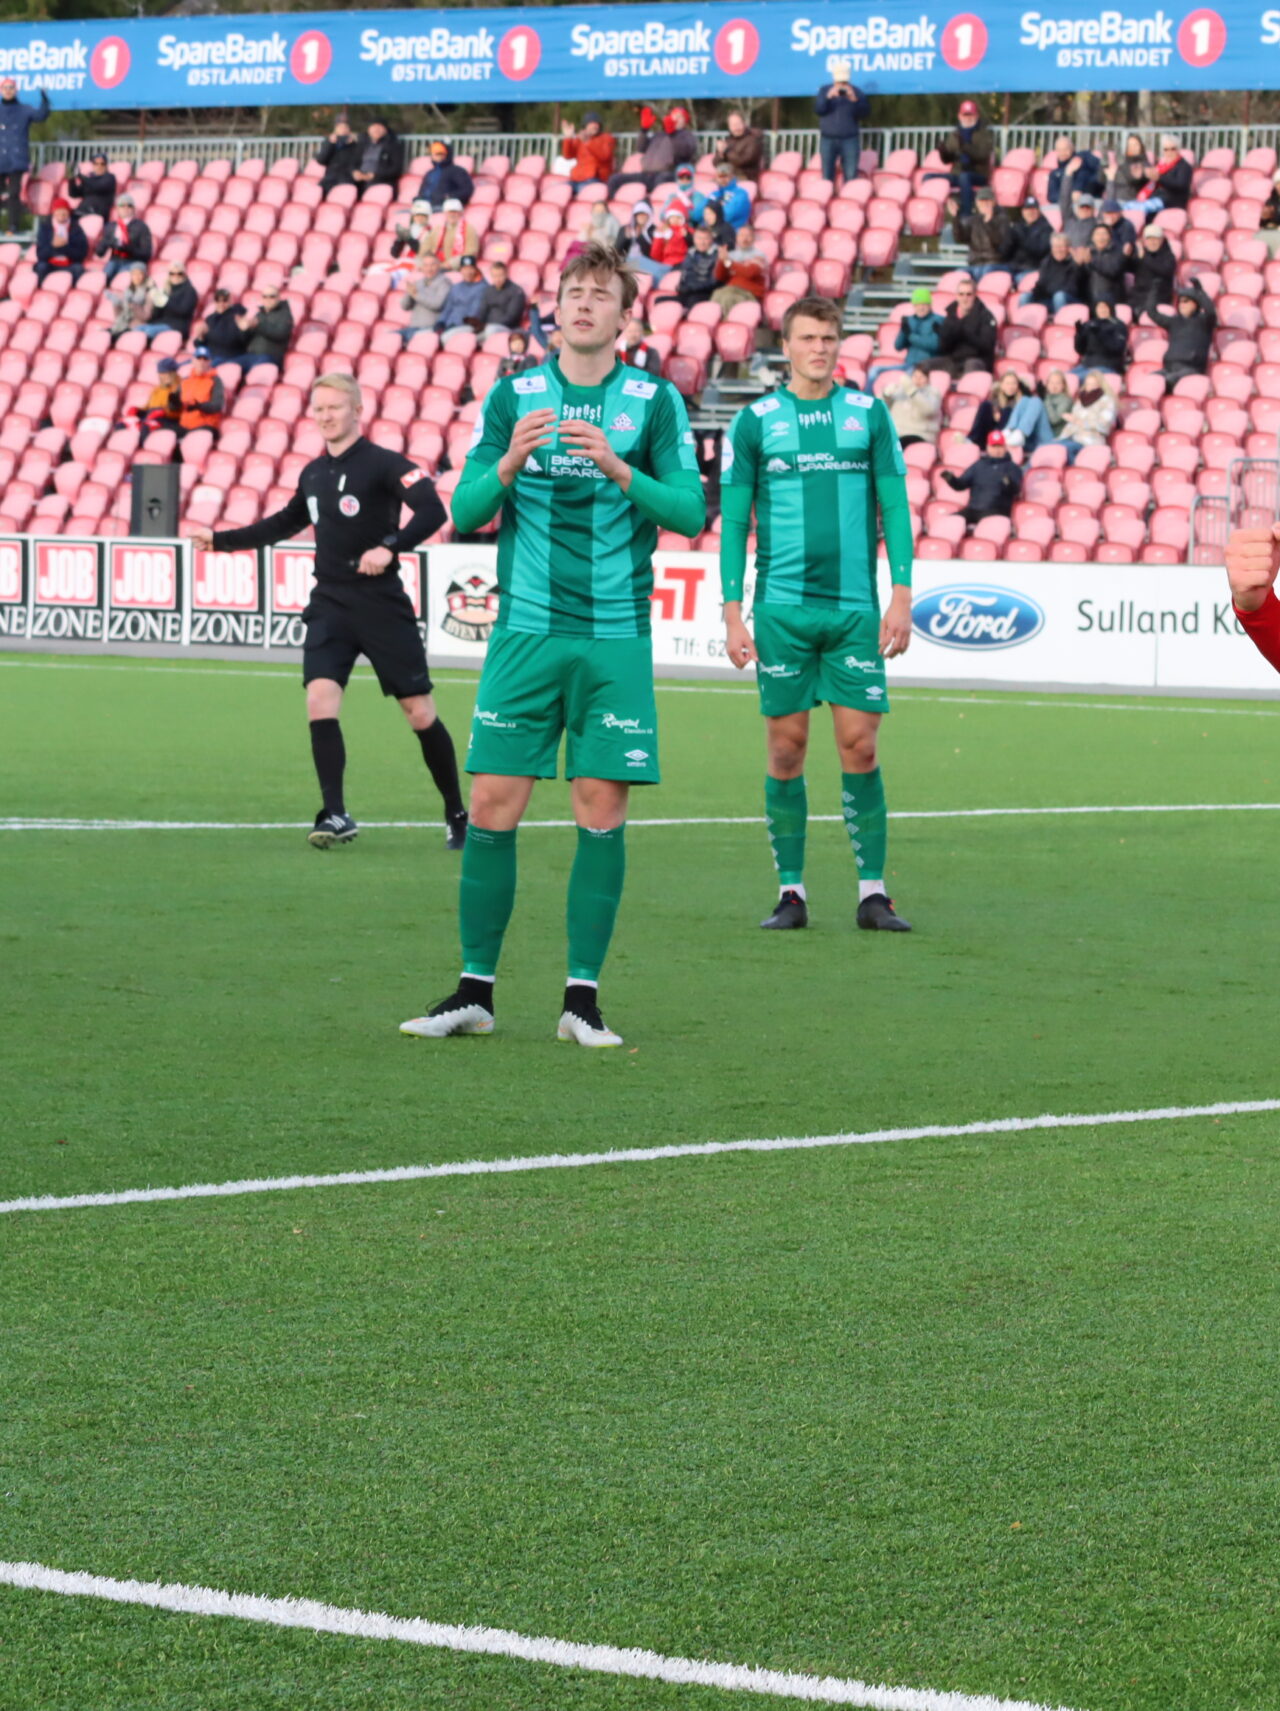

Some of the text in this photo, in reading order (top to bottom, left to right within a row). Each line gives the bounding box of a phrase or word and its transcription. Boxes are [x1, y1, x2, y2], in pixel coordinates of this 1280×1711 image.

[359, 28, 527, 71] SpareBank 1
[570, 20, 746, 65] SpareBank 1
[790, 15, 973, 60] SpareBank 1
[1020, 10, 1210, 56] SpareBank 1
[102, 45, 119, 79] 1
[157, 32, 320, 75] SpareBank 1
[604, 56, 711, 76] ØSTLANDET
[1056, 48, 1173, 67] ØSTLANDET
[0, 72, 87, 91] TLANDET
[187, 66, 286, 85] ØSTLANDET
[391, 63, 494, 81] ØSTLANDET
[550, 467, 608, 480] SPARE
[551, 455, 594, 467] BERG
[797, 453, 835, 463] BERG
[40, 546, 96, 599] JOB
[114, 550, 173, 603] JOB
[195, 552, 254, 605] JOB
[275, 552, 316, 606] JO
[33, 607, 103, 640] ZONE
[109, 611, 183, 642] ZONE
[191, 611, 265, 645] ZONE
[271, 615, 308, 646] ZO
[929, 593, 1020, 641] Ford
[1077, 599, 1199, 635] Sulland
[673, 638, 701, 657] Tlf:
